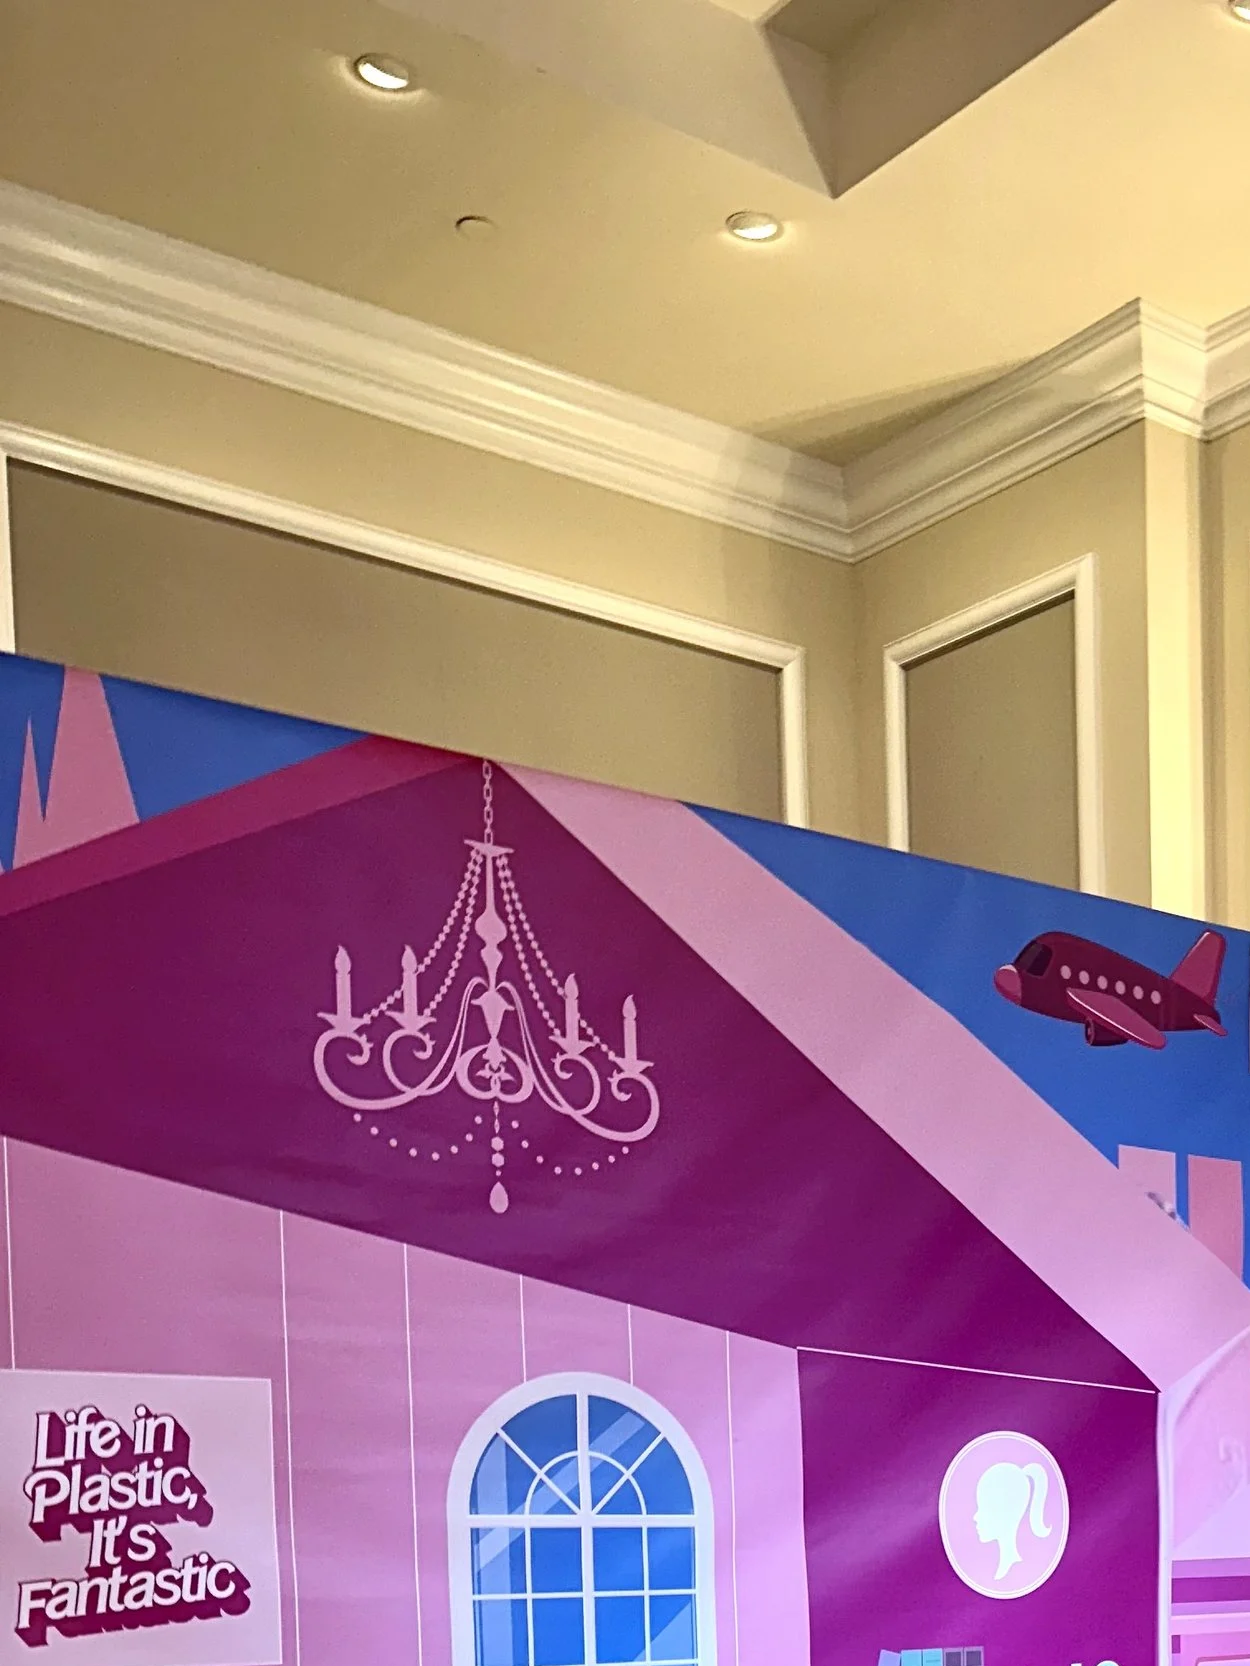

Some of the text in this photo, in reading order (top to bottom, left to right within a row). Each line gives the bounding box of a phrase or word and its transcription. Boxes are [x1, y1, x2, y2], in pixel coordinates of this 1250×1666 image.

[33, 1404, 184, 1470] Life in
[23, 1456, 208, 1533] Plastic,
[86, 1515, 171, 1572] It's
[15, 1552, 250, 1646] Fantastic
